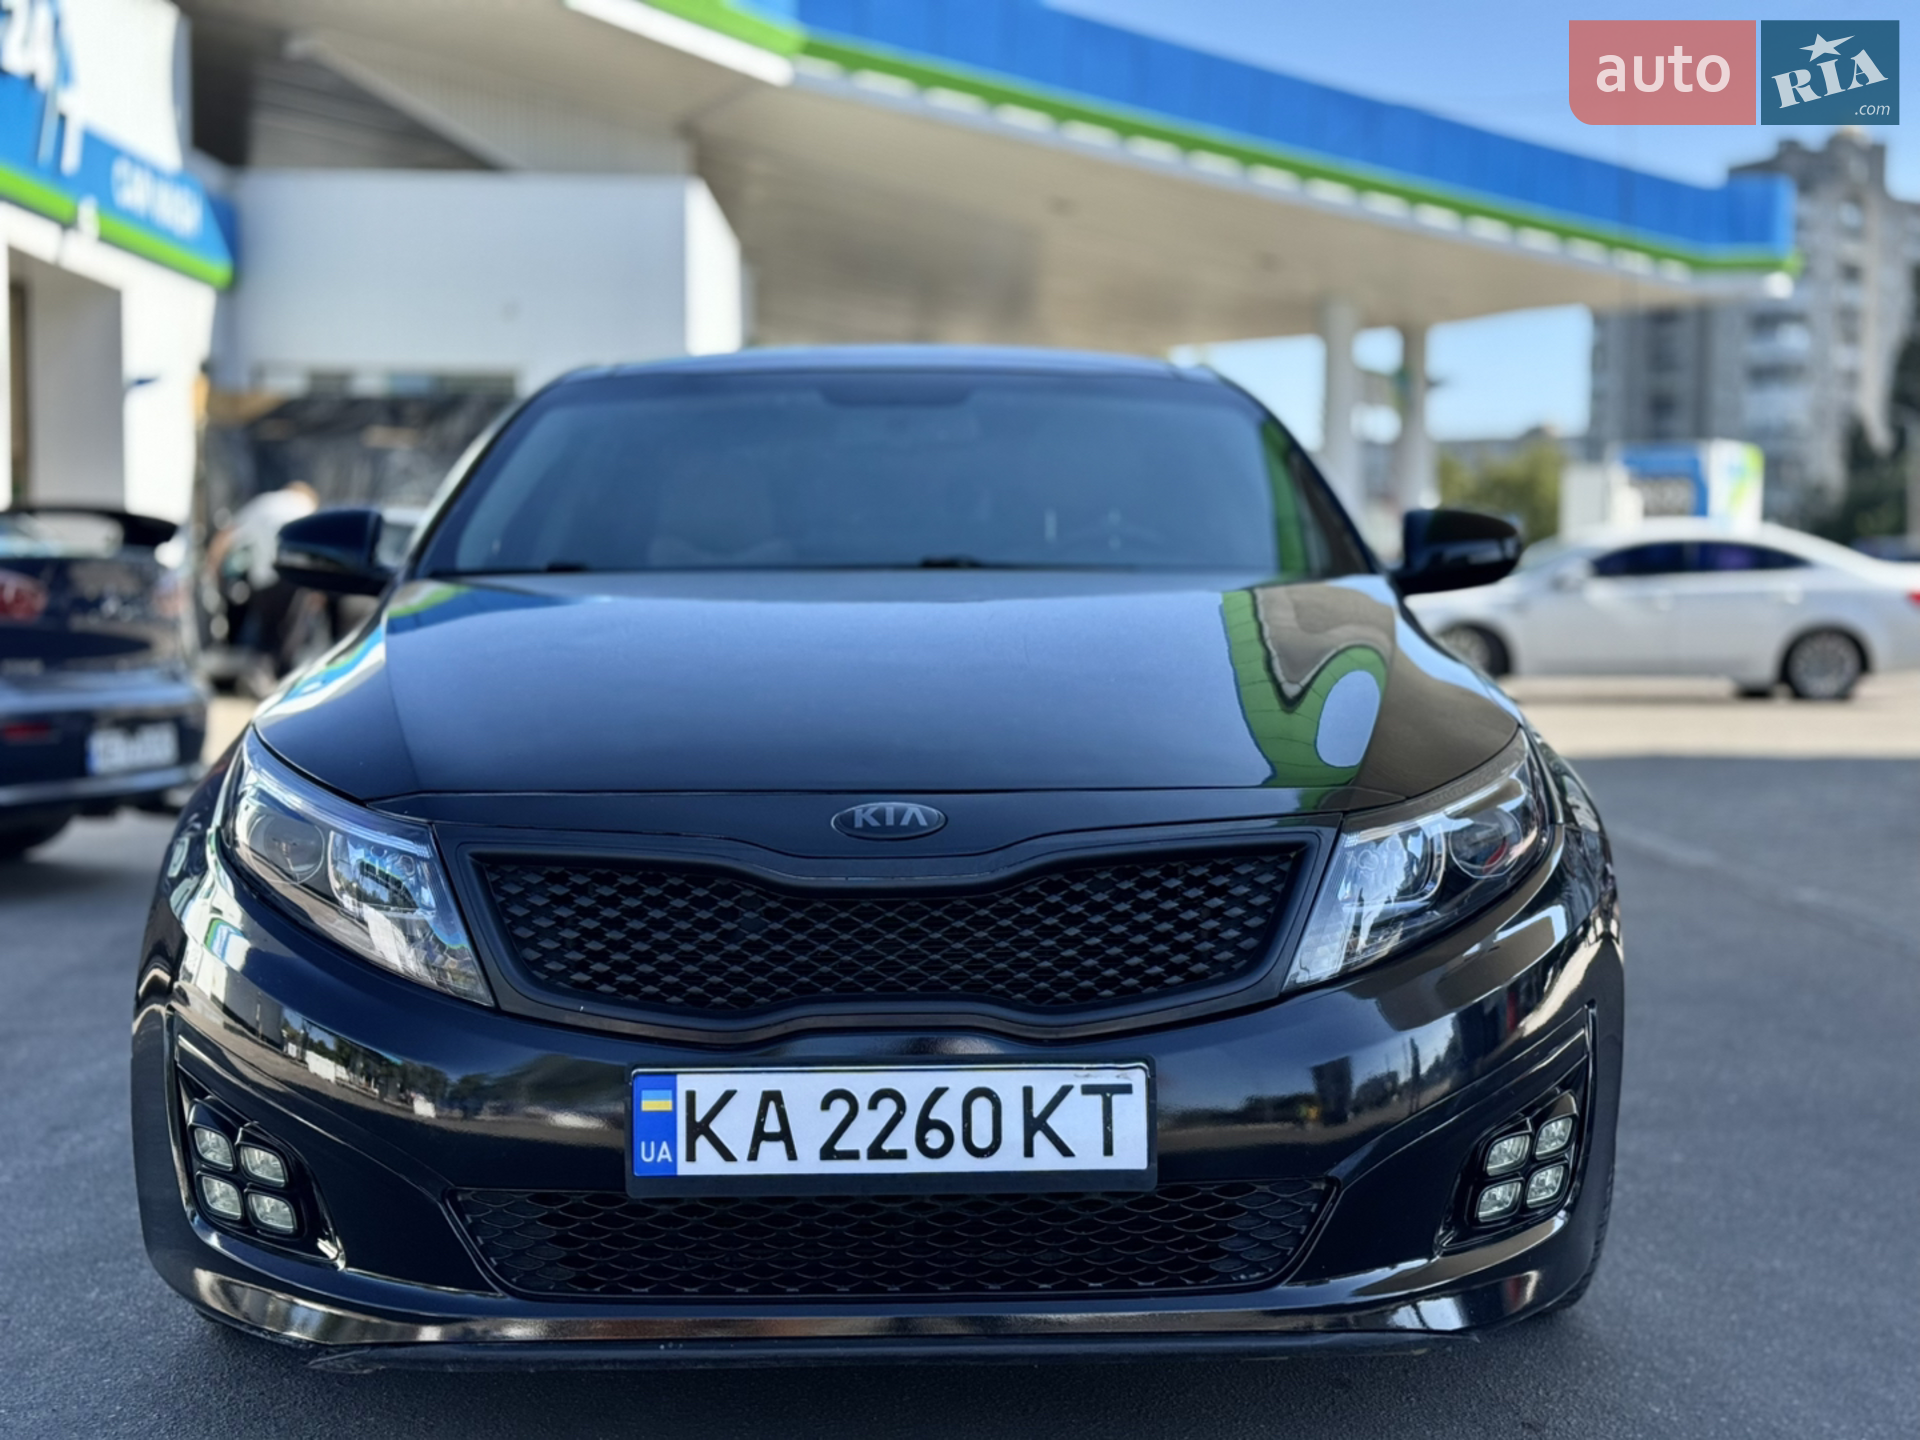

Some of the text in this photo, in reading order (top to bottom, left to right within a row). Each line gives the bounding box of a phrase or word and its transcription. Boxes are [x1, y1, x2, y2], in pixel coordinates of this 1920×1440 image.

[854, 806, 928, 828] KIA
[685, 1083, 1133, 1162] KA 2260 KT
[640, 1140, 673, 1163] UA
